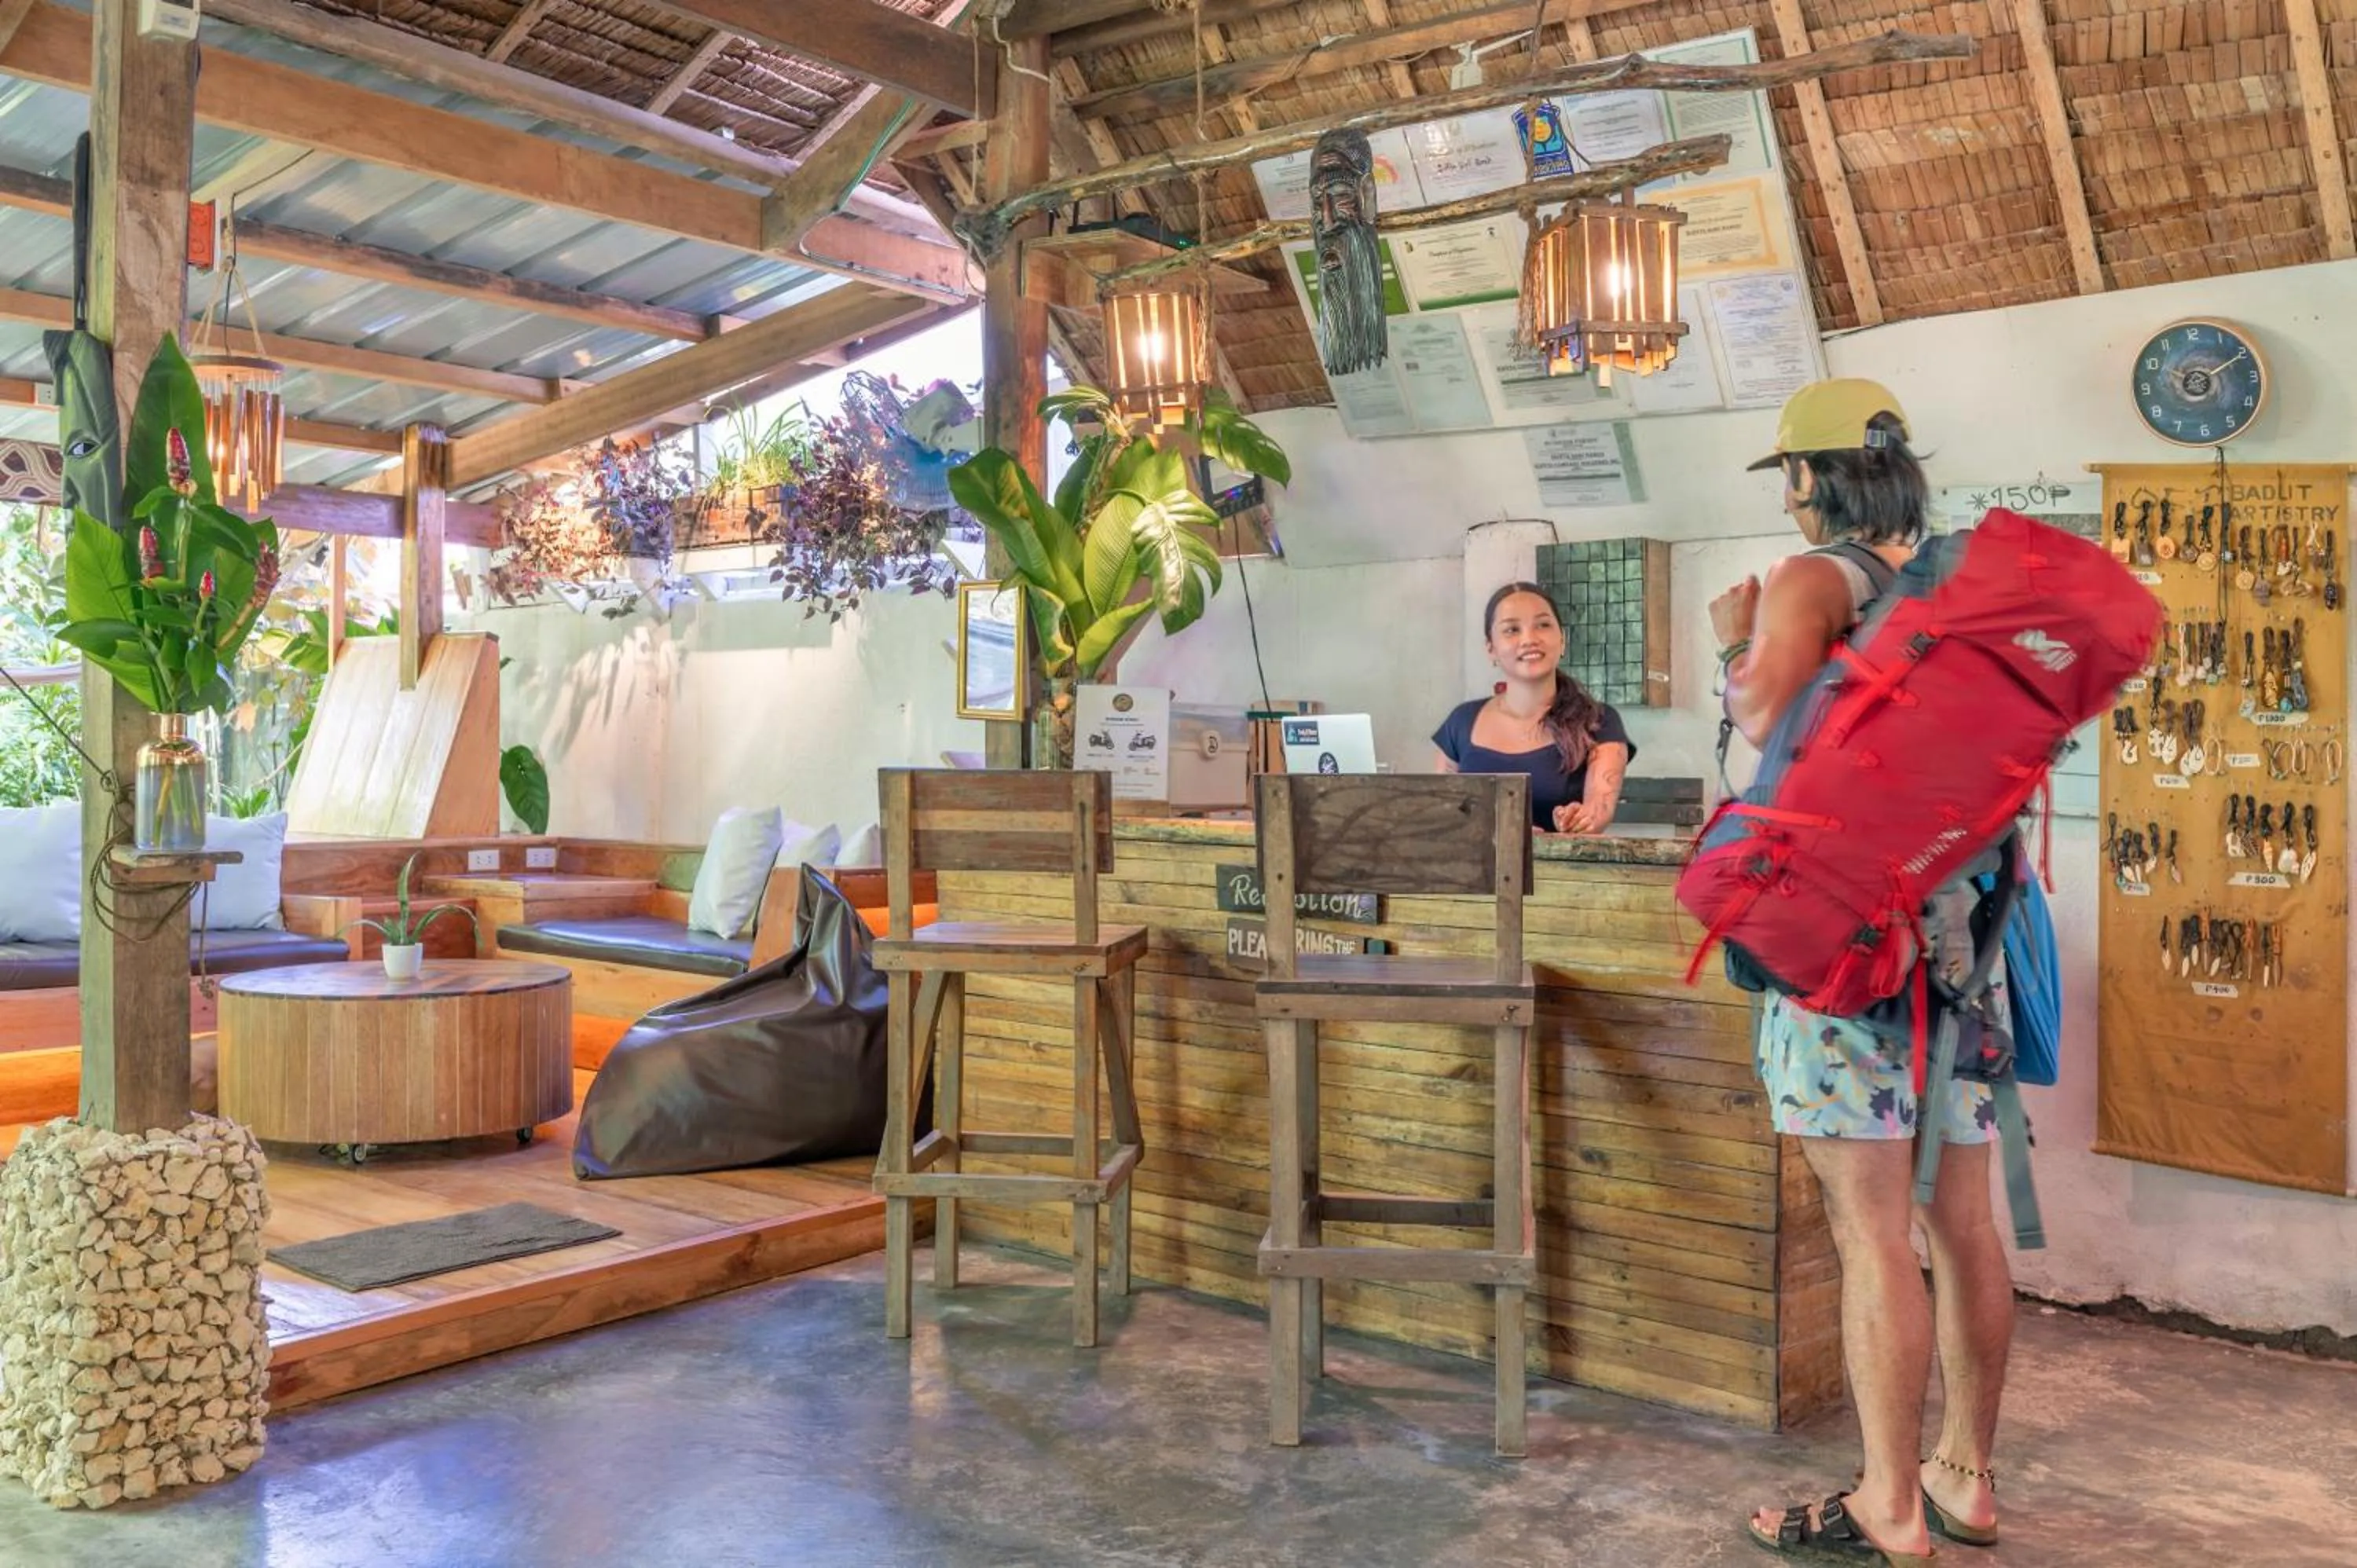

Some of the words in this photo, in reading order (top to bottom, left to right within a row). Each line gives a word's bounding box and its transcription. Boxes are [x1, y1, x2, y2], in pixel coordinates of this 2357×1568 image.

[2187, 328, 2199, 340] 12
[2161, 339, 2170, 351] 11
[2238, 346, 2248, 359] 2
[2146, 357, 2159, 370] 10
[2249, 370, 2258, 383] 3
[2141, 383, 2150, 395] 9
[2243, 395, 2253, 407] 4
[2151, 405, 2161, 418] 8
[2174, 420, 2182, 433] 7
[2225, 415, 2235, 427] 5
[2200, 424, 2210, 437] 6
[2231, 484, 2312, 501] BADLIT
[2231, 505, 2340, 522] ARTISTRY
[1230, 874, 1362, 918] Retion
[1228, 928, 1268, 961] PLEA
[1296, 928, 1335, 954] RING
